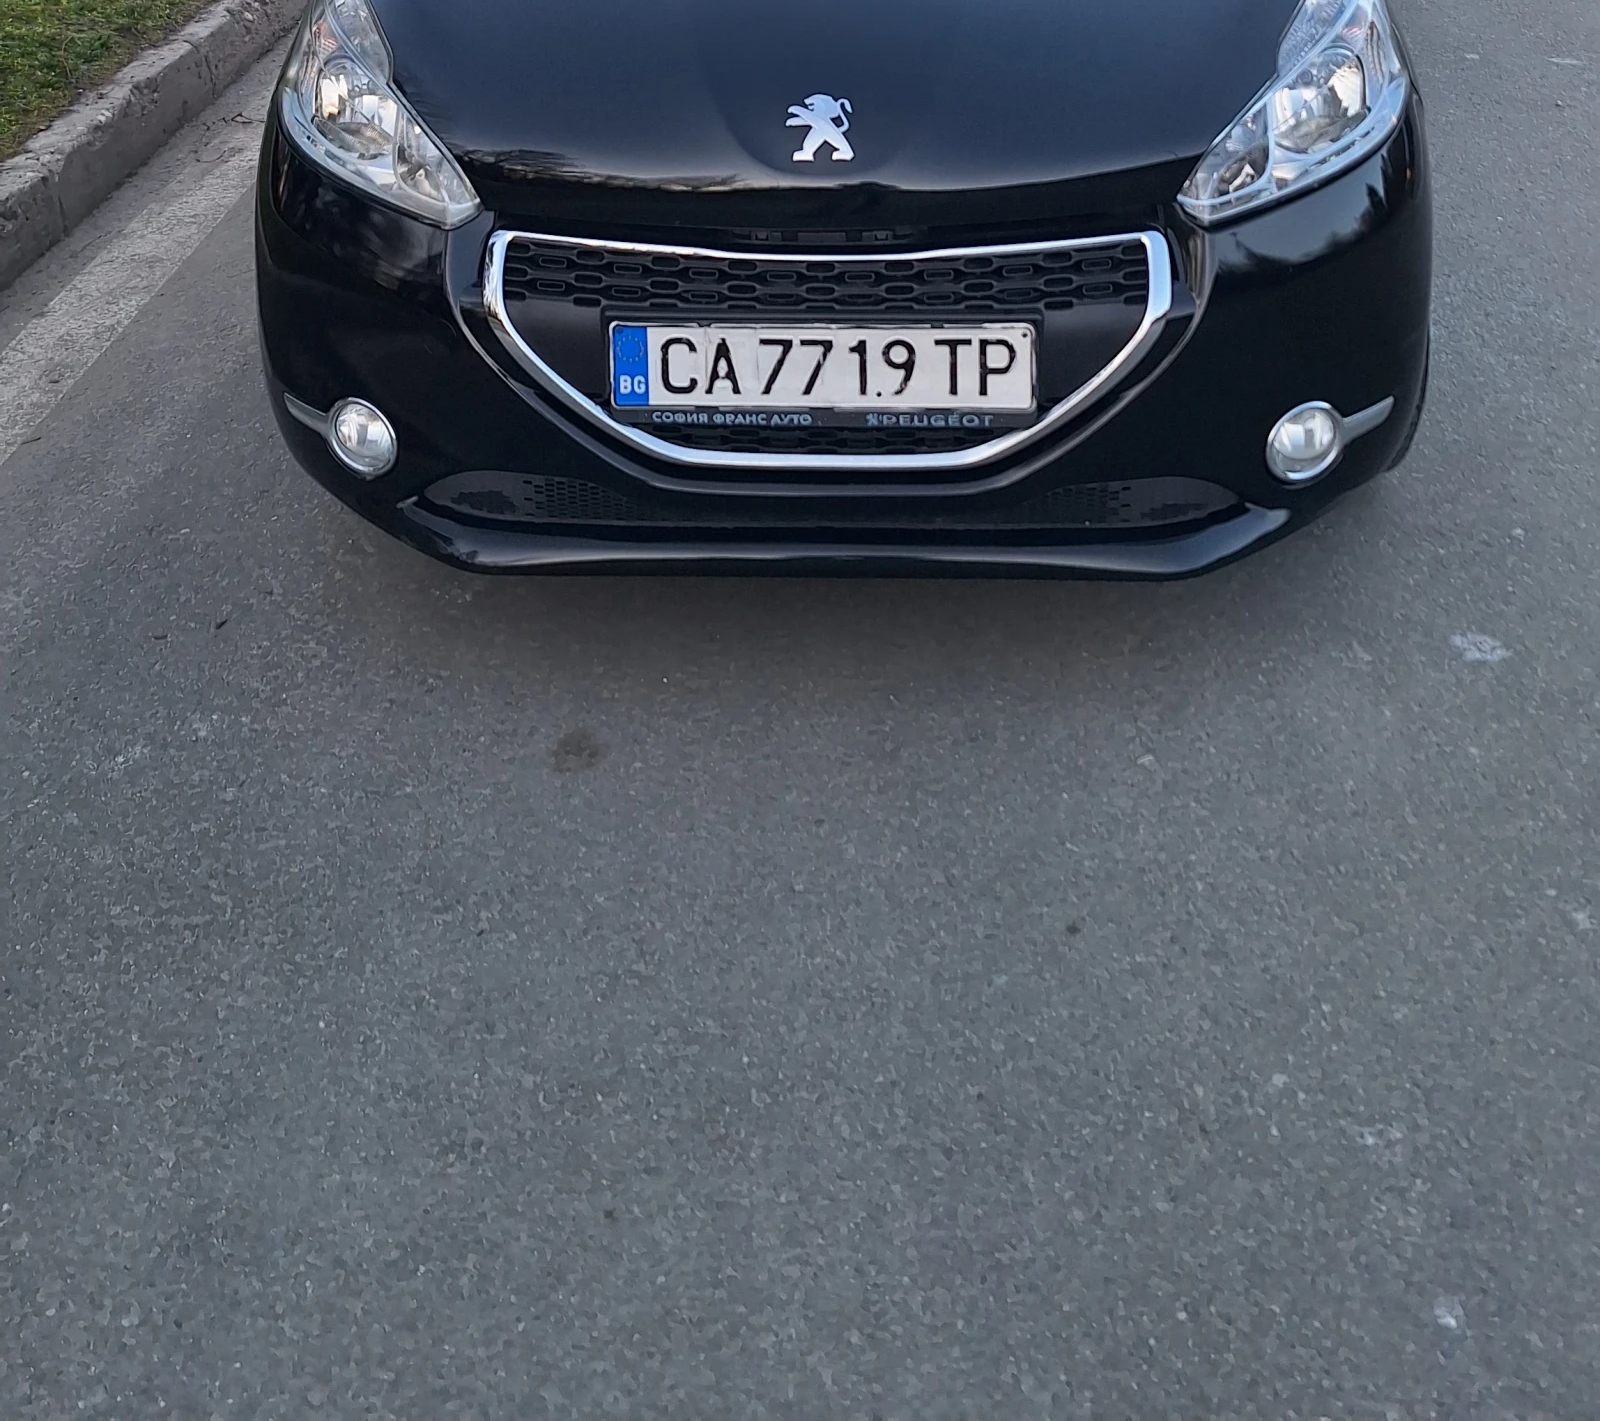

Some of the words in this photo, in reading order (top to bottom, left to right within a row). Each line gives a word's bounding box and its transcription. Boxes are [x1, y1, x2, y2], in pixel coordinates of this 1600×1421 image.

[660, 337, 742, 394] CA
[759, 338, 916, 396] 7719
[934, 338, 1016, 396] TP
[619, 375, 646, 394] BG
[652, 411, 708, 424] СОФИЯ
[712, 412, 767, 425] ФРАНС
[771, 413, 813, 427] АУТО
[882, 414, 994, 427] PEUGEOT
